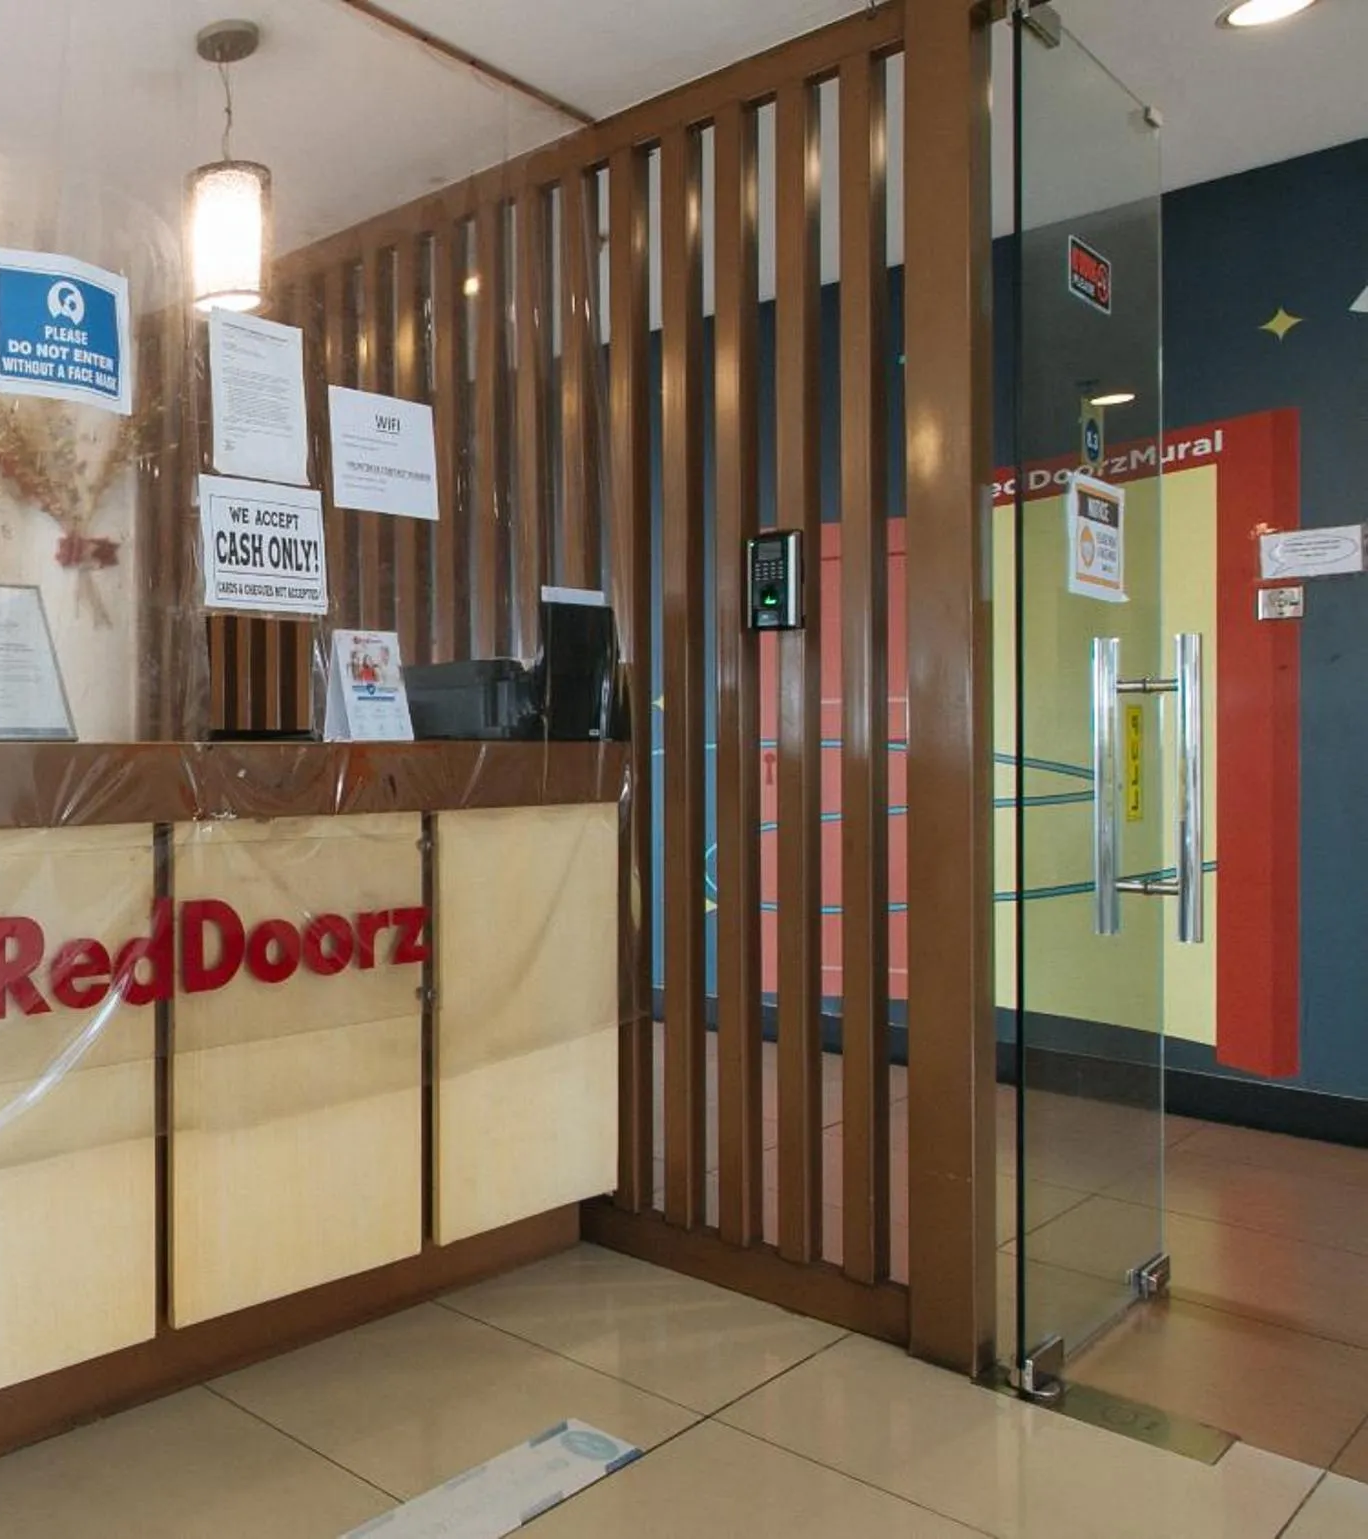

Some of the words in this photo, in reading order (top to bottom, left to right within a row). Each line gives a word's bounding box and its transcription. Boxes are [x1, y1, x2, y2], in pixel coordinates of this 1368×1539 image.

[45, 325, 88, 346] PLEASE
[8, 338, 32, 355] DO
[36, 343, 69, 360] NOT
[73, 349, 114, 371] ENTER
[1, 356, 55, 377] WITHOUT
[57, 363, 66, 379] A
[68, 366, 93, 384] FACE
[229, 506, 249, 524] WE
[255, 509, 299, 531] ACCEPT
[216, 530, 264, 568] CASH
[268, 536, 319, 573] ONLY!
